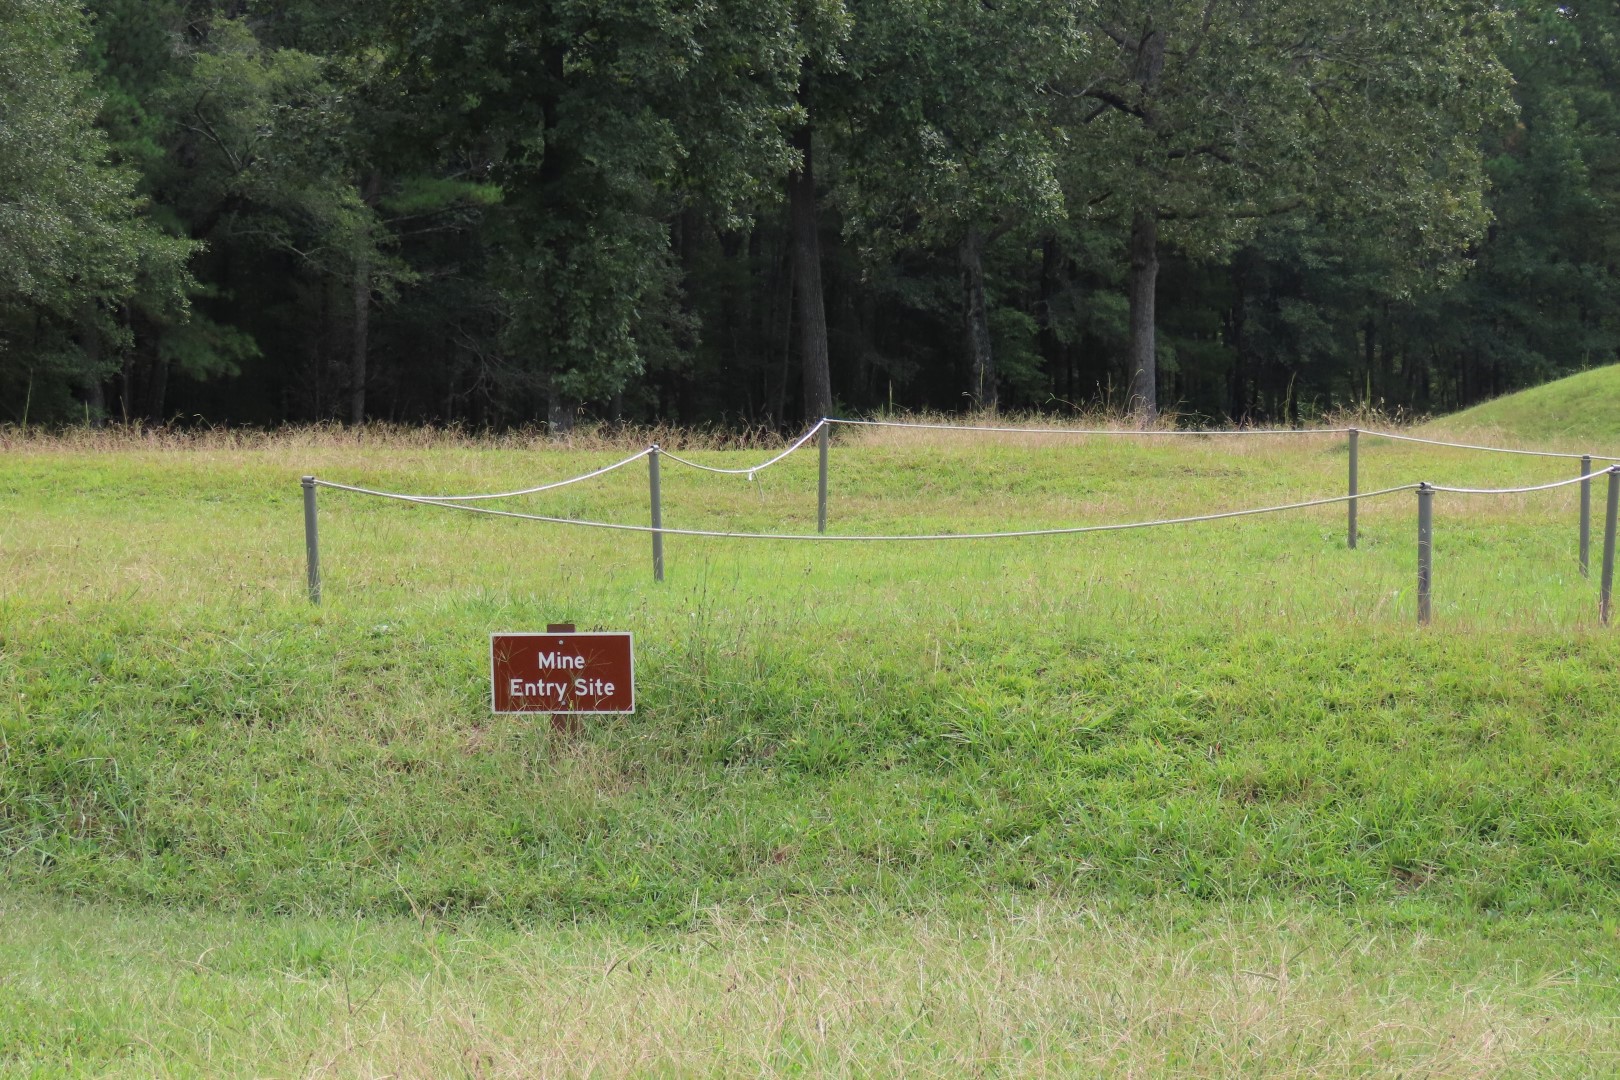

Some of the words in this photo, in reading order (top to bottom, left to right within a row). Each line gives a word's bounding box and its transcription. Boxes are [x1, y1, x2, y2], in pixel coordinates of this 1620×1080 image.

[538, 651, 586, 670] Mine
[510, 678, 567, 702] Entry
[574, 678, 615, 697] Site
